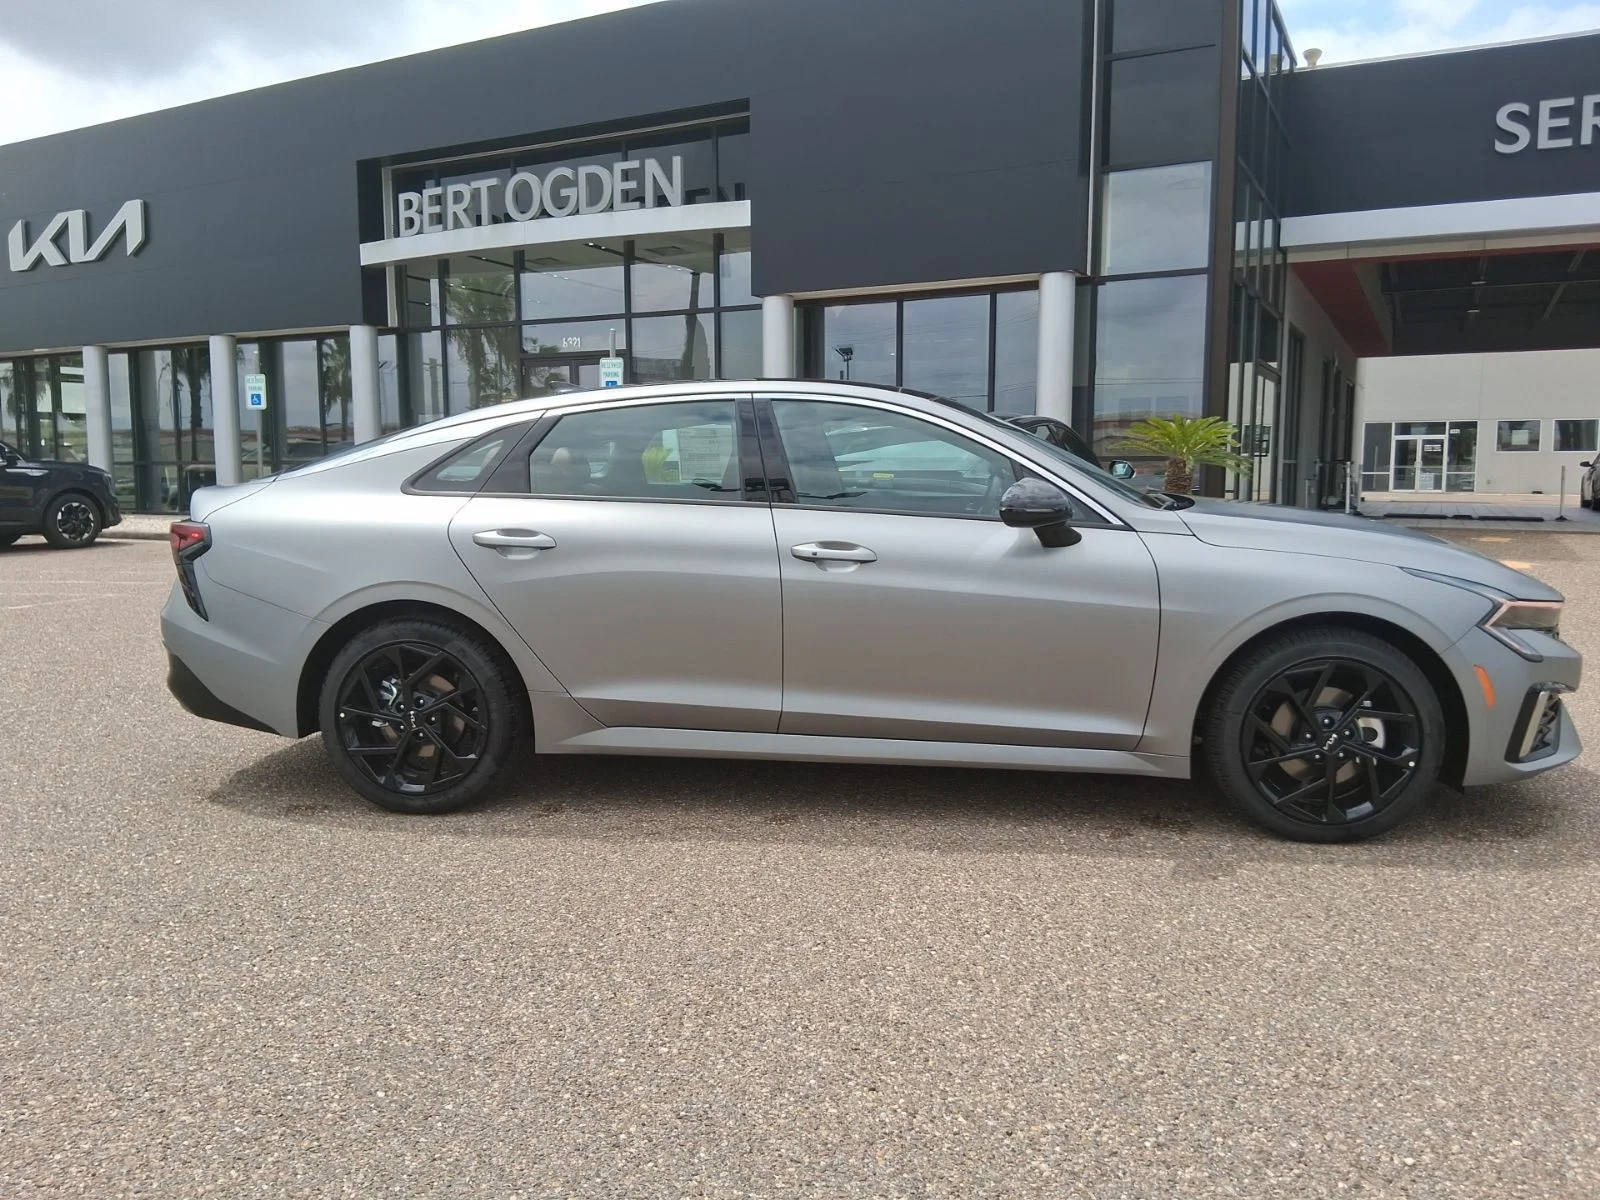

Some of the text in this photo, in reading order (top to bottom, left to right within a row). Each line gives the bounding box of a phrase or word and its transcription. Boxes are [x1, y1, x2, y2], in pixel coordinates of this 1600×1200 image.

[8, 198, 146, 272] KIA
[398, 155, 685, 238] BERT OGDEN
